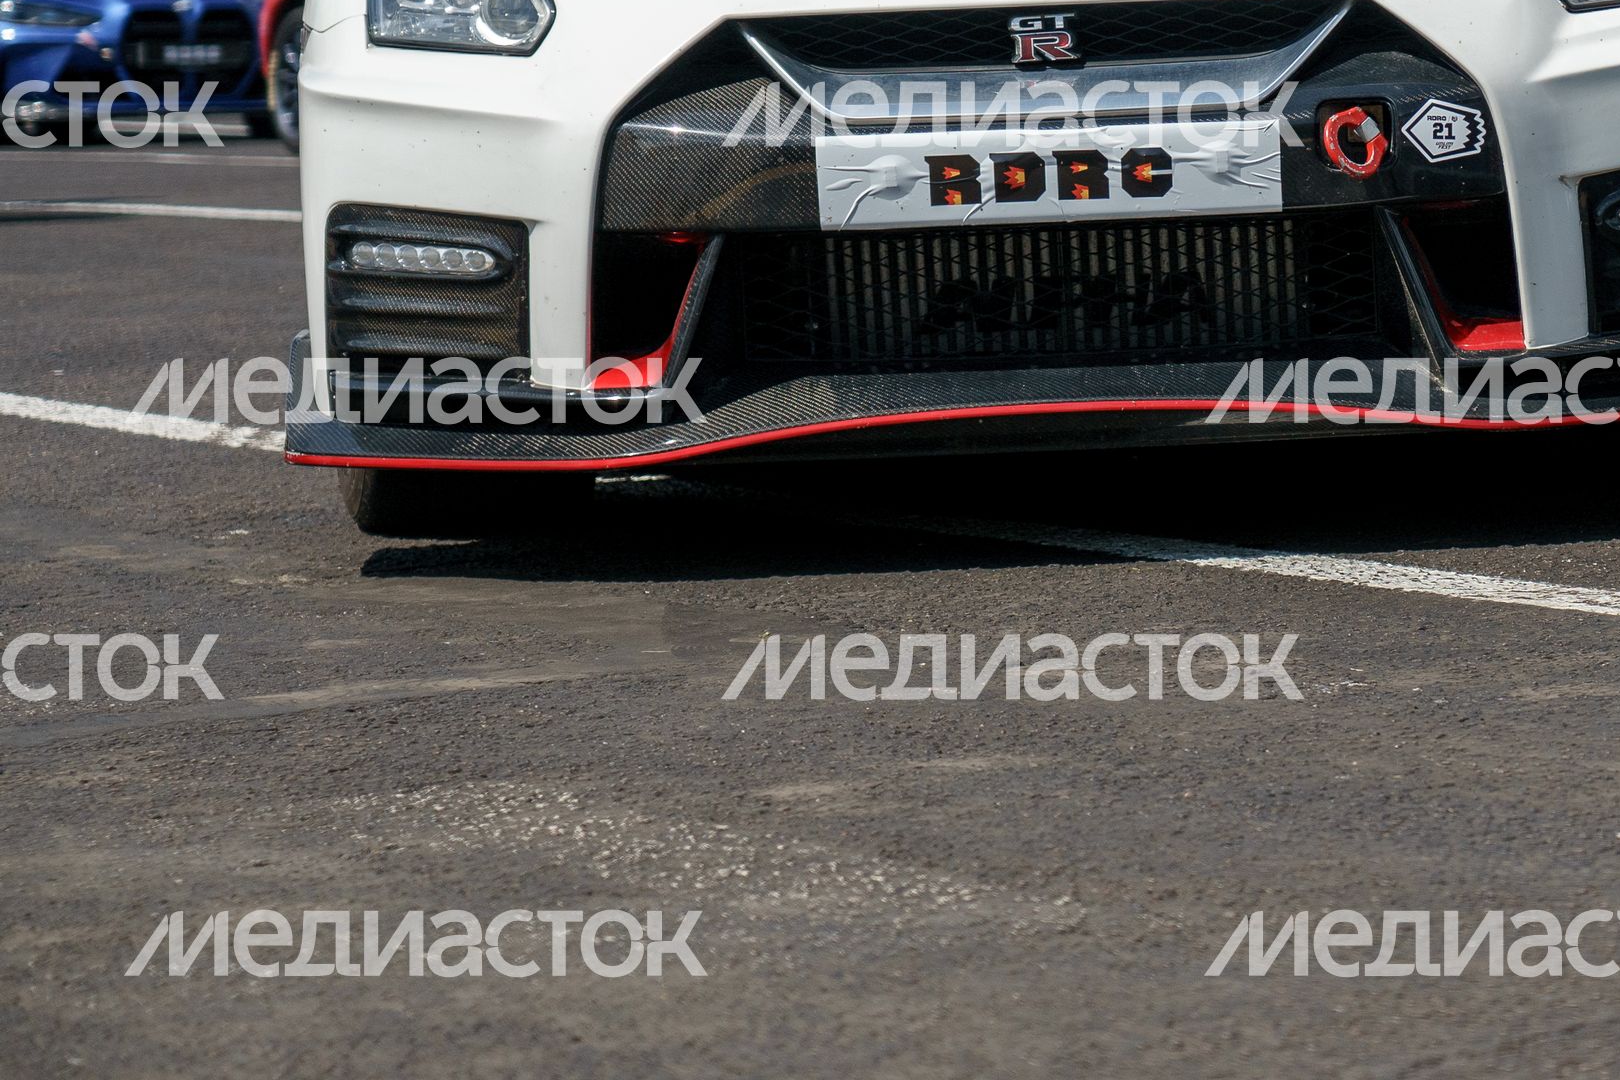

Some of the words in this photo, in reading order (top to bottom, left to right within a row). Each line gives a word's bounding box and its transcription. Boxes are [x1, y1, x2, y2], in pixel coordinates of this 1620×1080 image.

[1008, 13, 1075, 32] GT
[1432, 122, 1456, 140] 21
[924, 146, 1174, 207] RDRC
